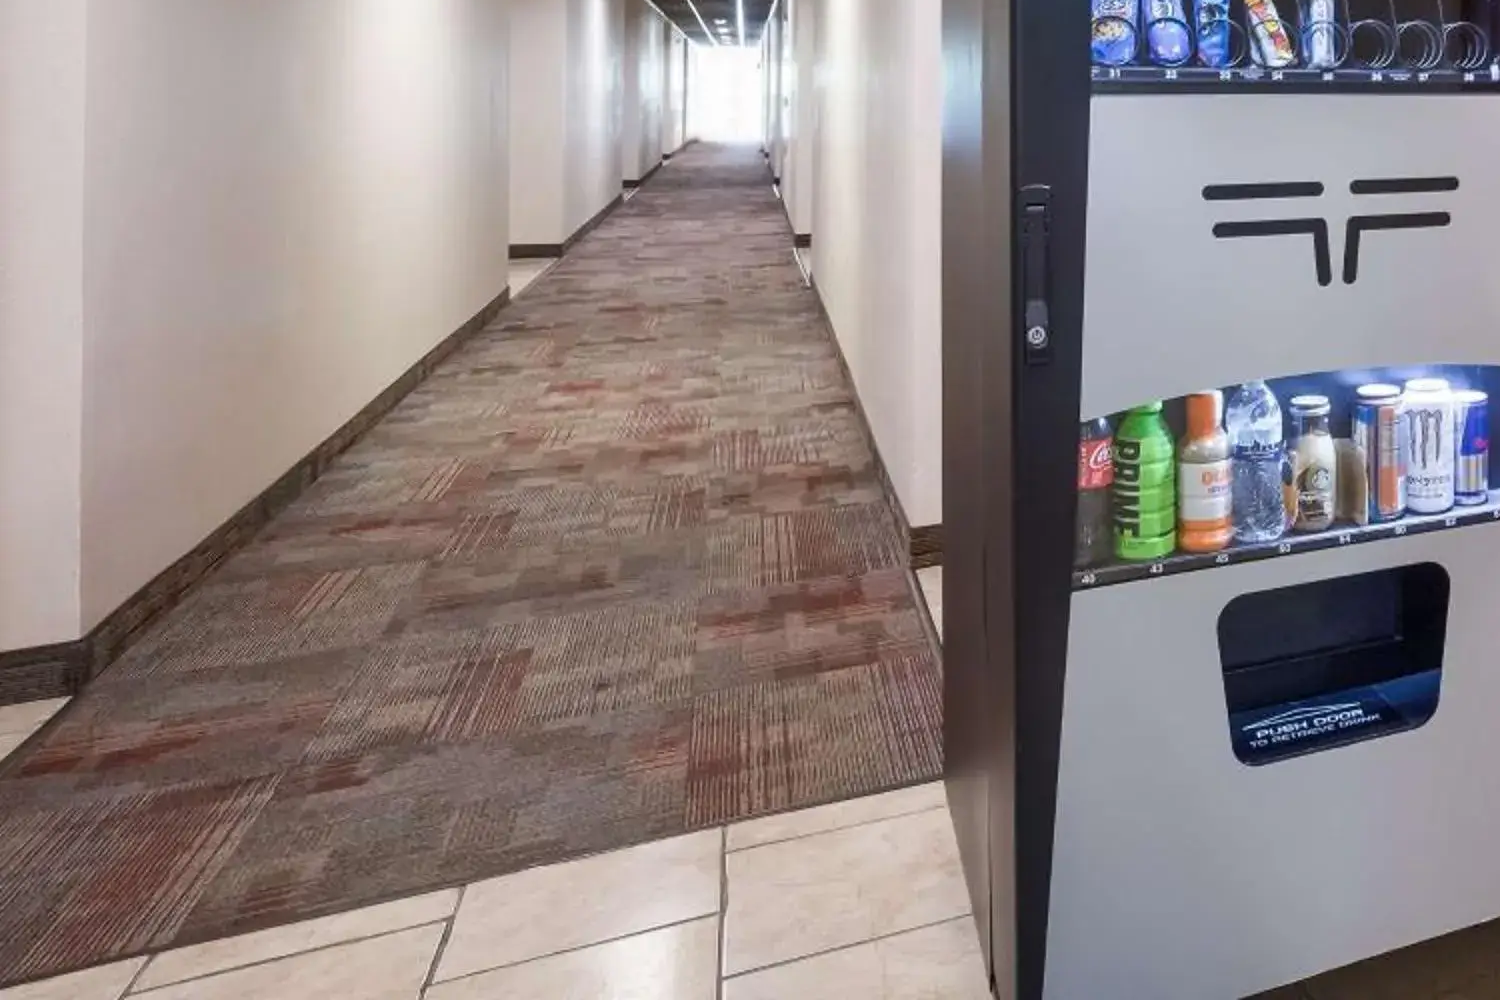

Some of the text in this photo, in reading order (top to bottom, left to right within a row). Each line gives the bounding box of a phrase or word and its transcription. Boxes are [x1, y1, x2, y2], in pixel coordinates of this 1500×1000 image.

[1115, 438, 1141, 538] PRIME
[1249, 713, 1381, 749] TO RETRIEVE DRINK
[1256, 709, 1363, 738] PUSH DOOR
